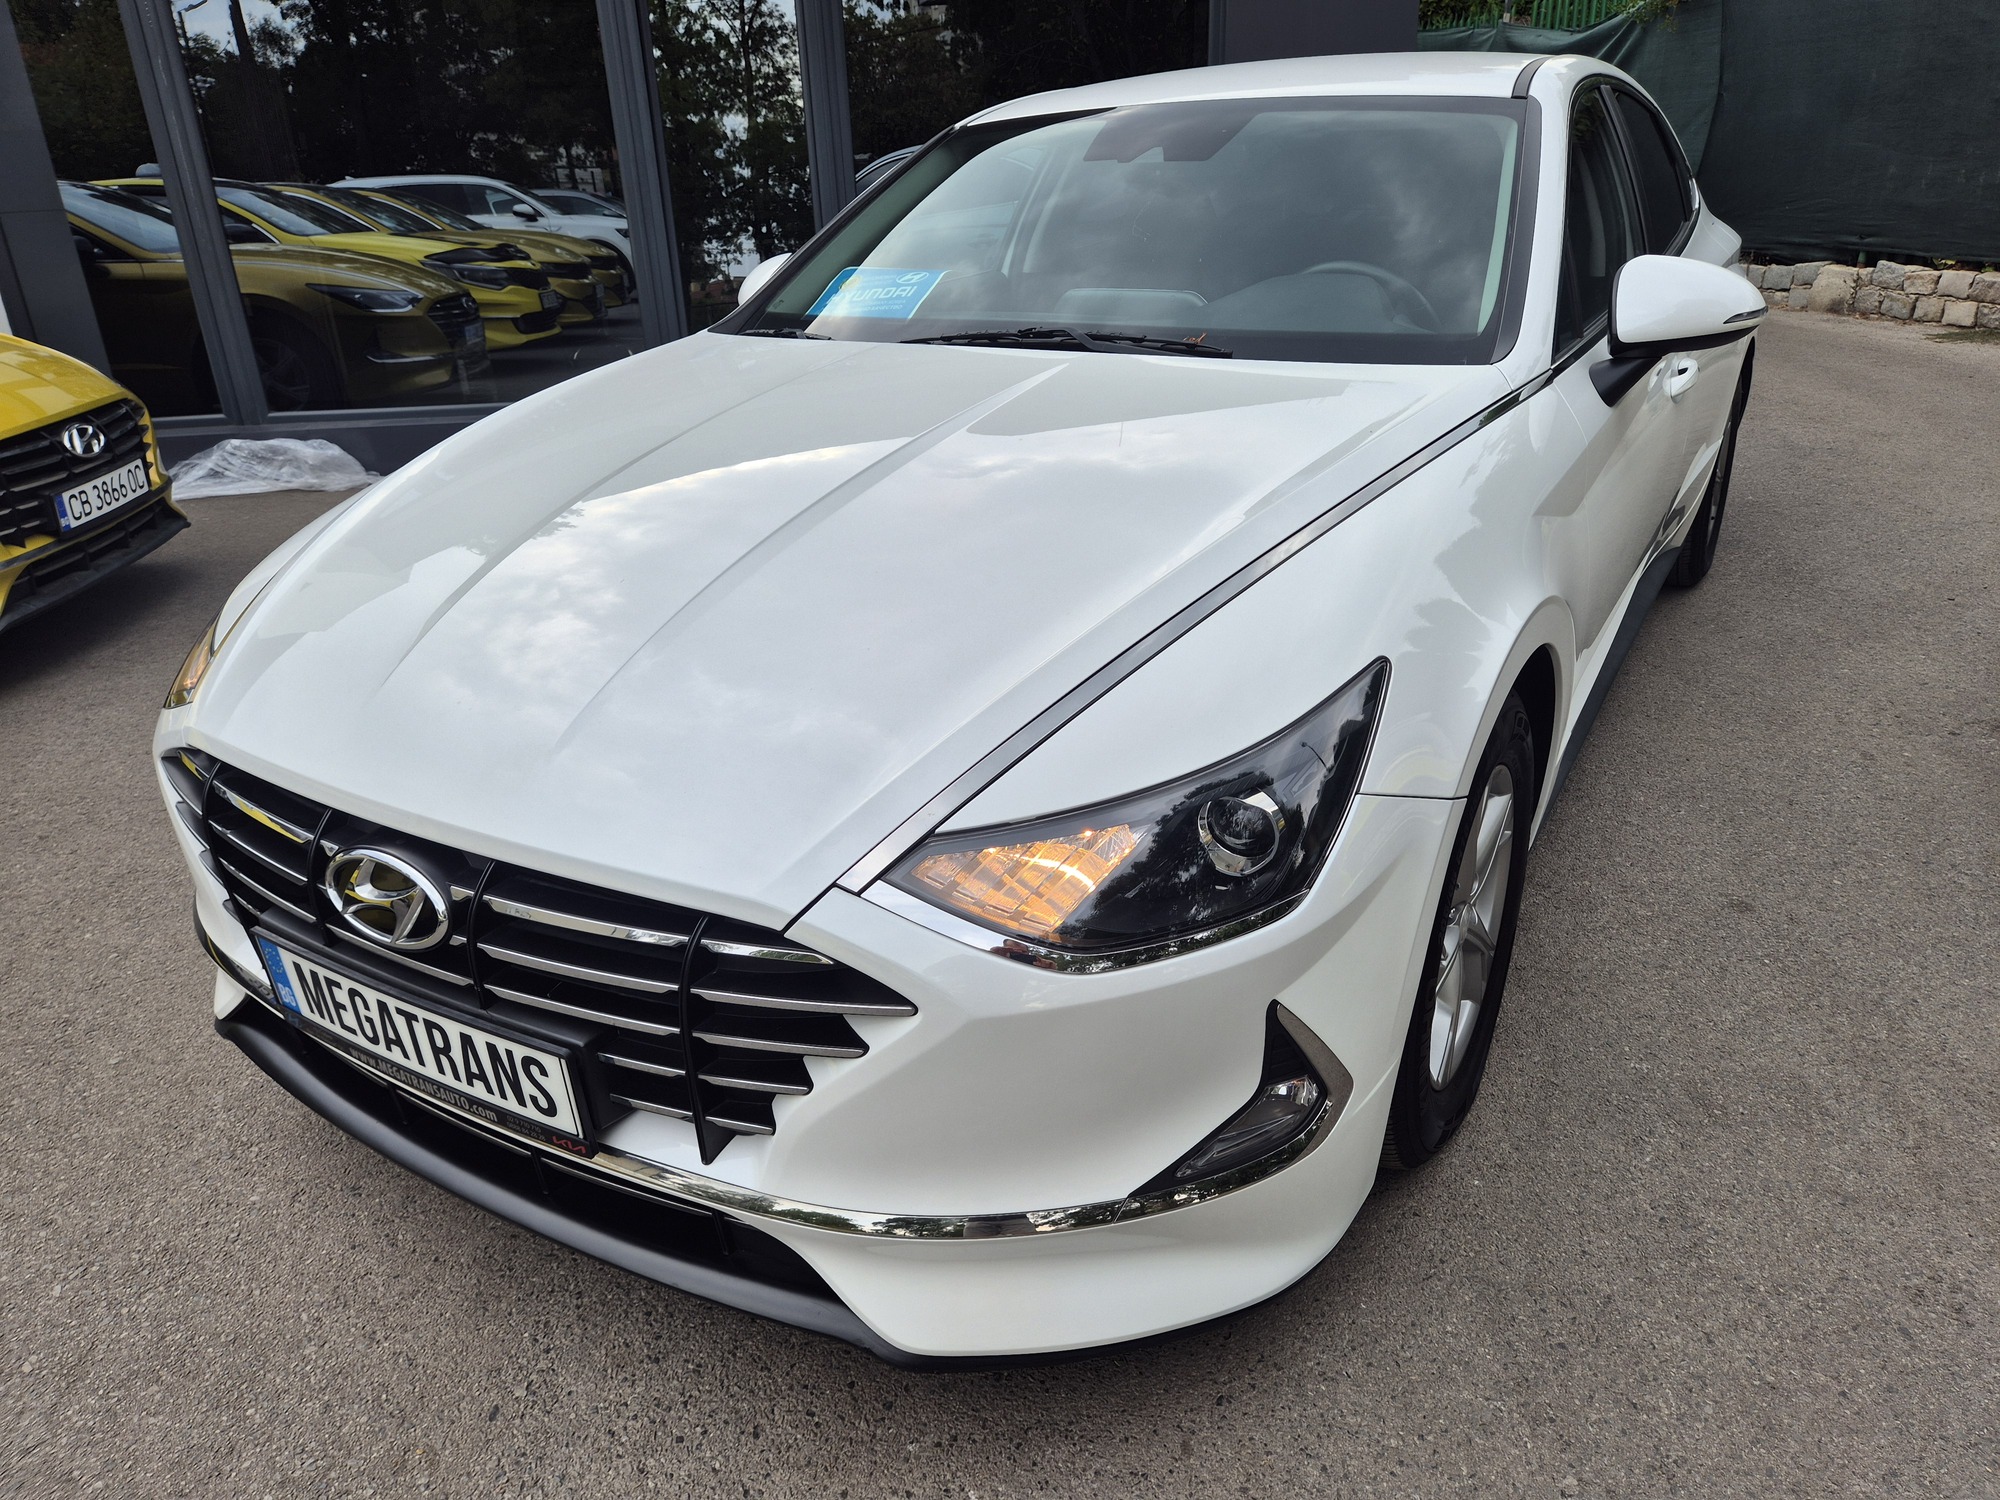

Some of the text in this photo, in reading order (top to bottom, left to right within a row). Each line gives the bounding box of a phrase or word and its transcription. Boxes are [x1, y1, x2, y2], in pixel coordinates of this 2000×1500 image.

[68, 490, 92, 521] CB
[92, 473, 128, 511] 3866
[277, 982, 297, 1008] BG
[293, 960, 558, 1118] MEGATRANS
[350, 1047, 499, 1123] www.MEGATRANSAUTO.com
